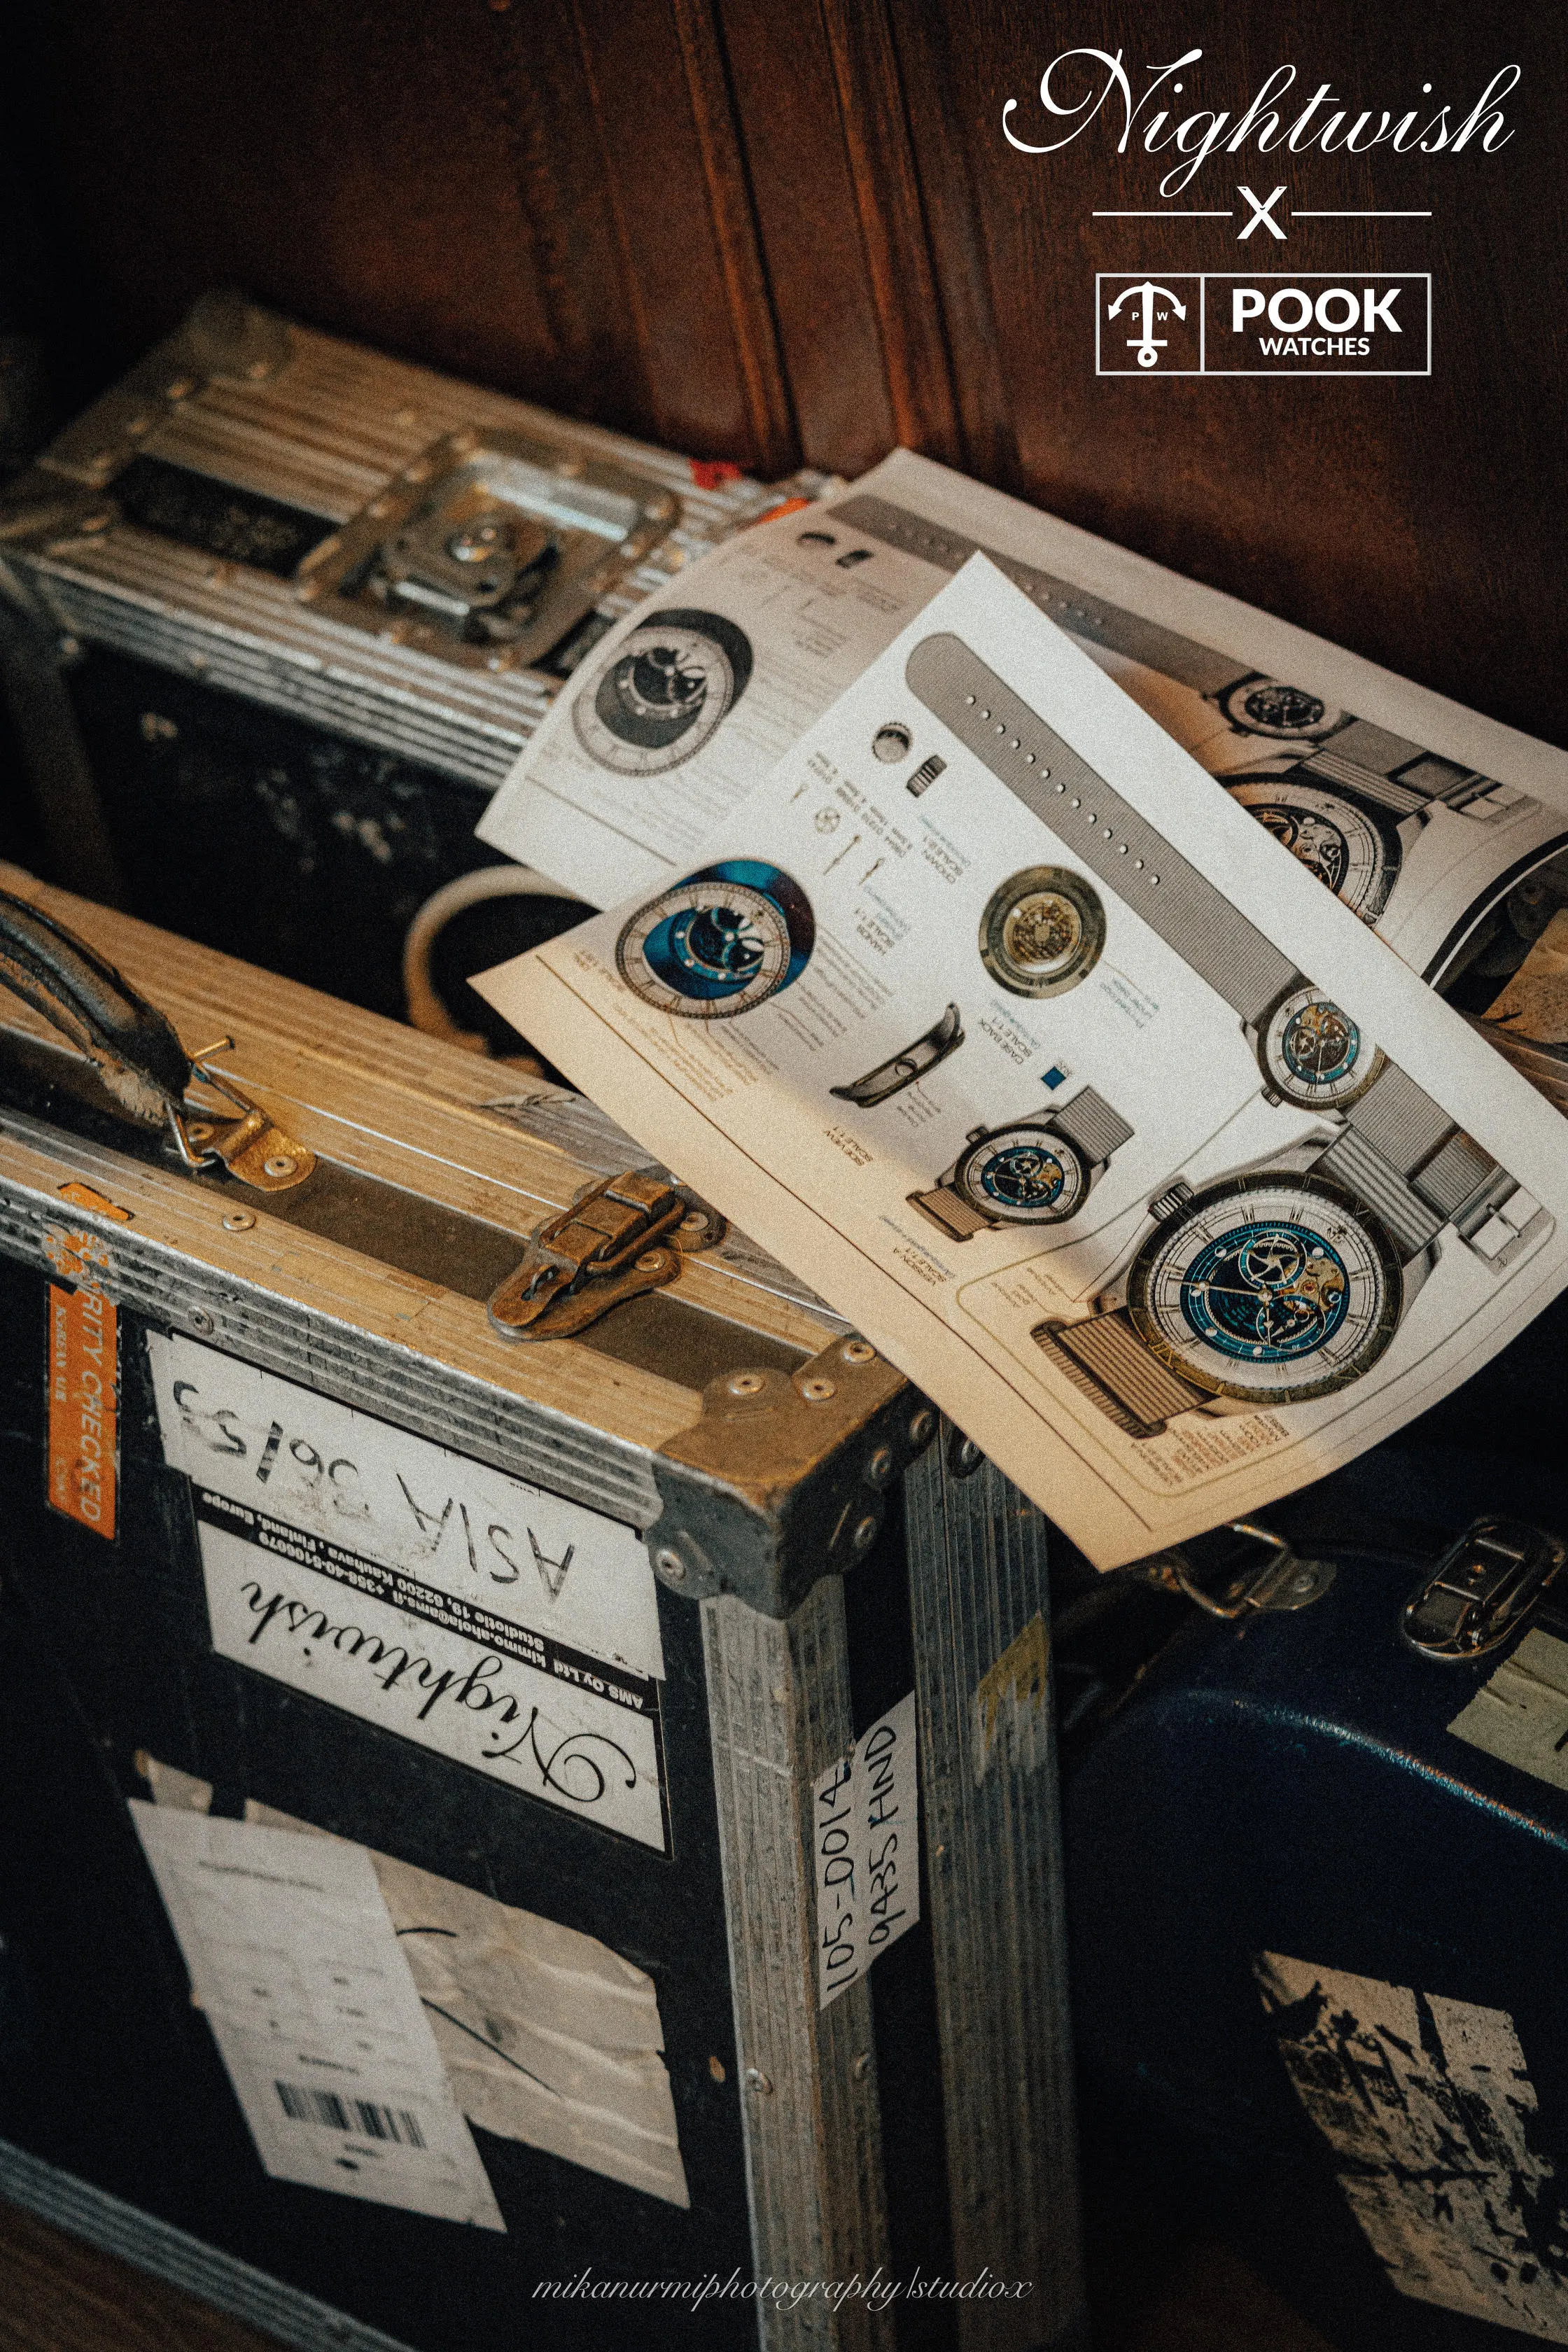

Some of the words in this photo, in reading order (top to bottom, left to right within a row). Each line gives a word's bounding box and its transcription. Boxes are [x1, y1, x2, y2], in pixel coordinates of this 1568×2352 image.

[79, 1370, 103, 1522] CHECKED
[200, 1487, 255, 1525] Europe
[396, 1473, 575, 1602] ASIA
[445, 1595, 470, 1618] 19,
[474, 1608, 544, 1651] Studiotie
[240, 1579, 637, 1803] Nightwish
[553, 1660, 578, 1684] Ltd
[582, 1670, 604, 1693] Oy
[608, 1682, 643, 1710] AMS
